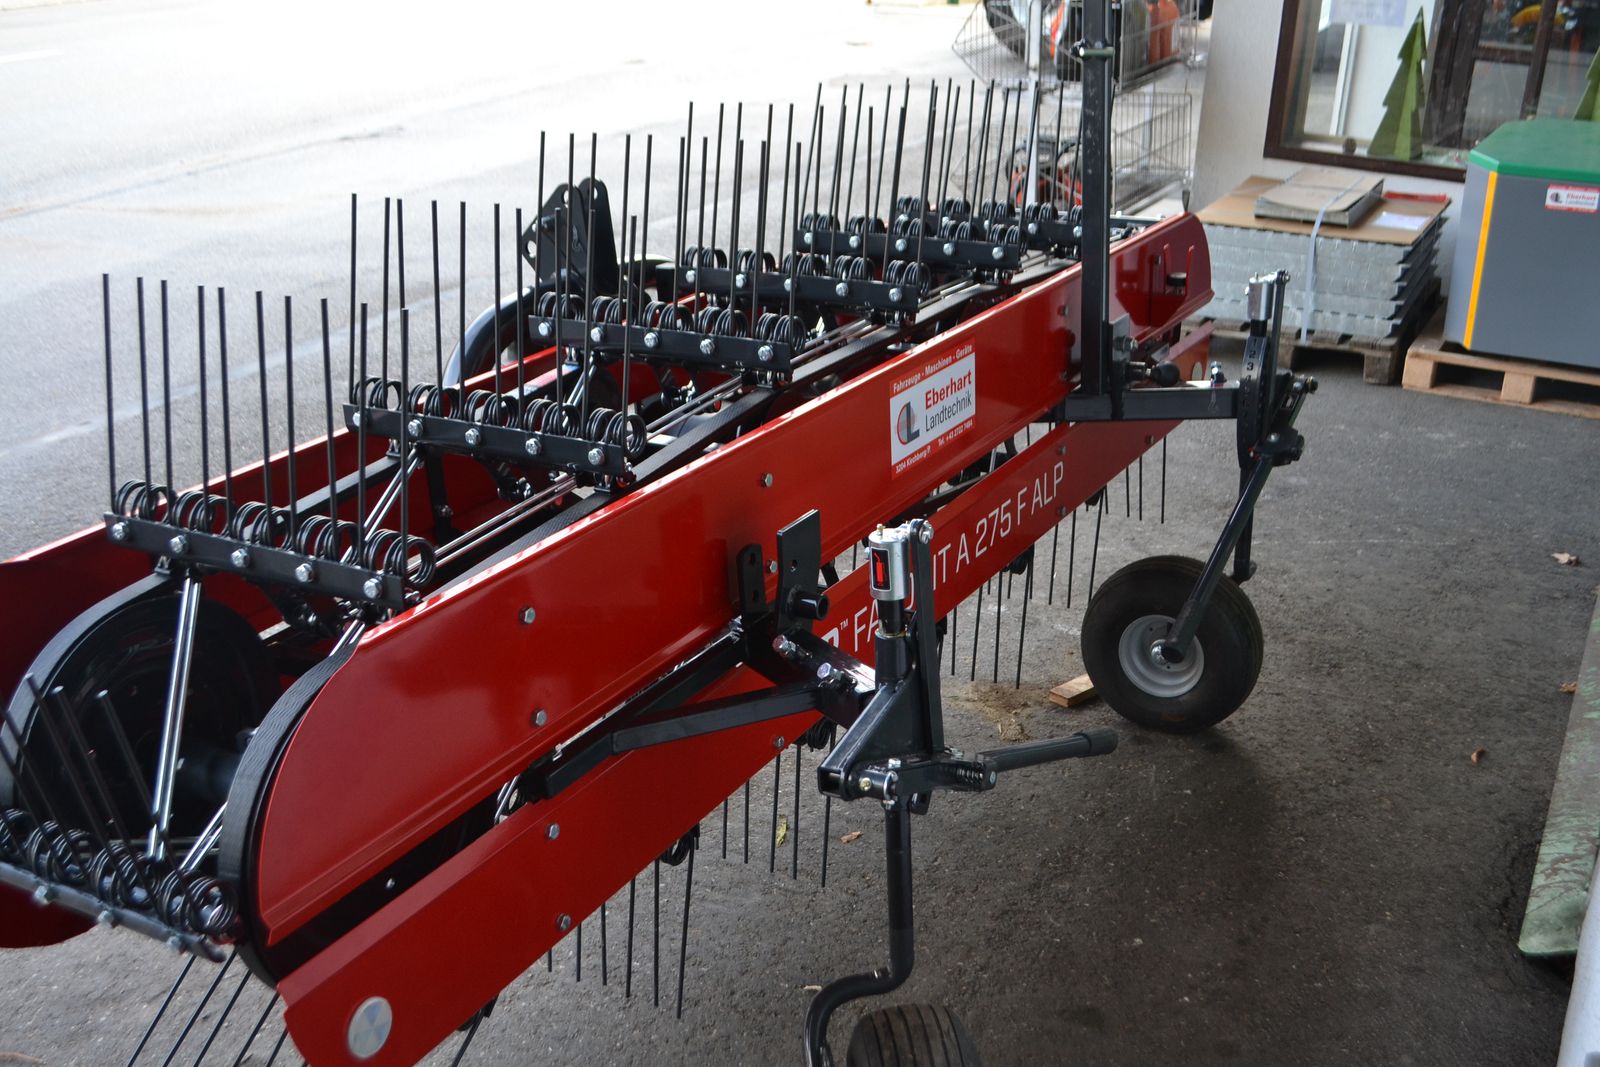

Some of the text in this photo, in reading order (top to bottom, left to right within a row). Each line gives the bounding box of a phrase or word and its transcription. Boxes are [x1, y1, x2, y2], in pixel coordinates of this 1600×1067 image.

[893, 373, 921, 394] Fahrzeuge
[925, 355, 952, 375] Maschinen
[956, 344, 973, 359] Geräte
[1247, 362, 1254, 371] 3
[925, 369, 972, 410] Eberhart
[925, 390, 972, 433] Landtechnik
[956, 532, 970, 573] A
[975, 498, 1012, 558] 275
[1017, 486, 1028, 526] F
[1031, 461, 1064, 516] ALP
